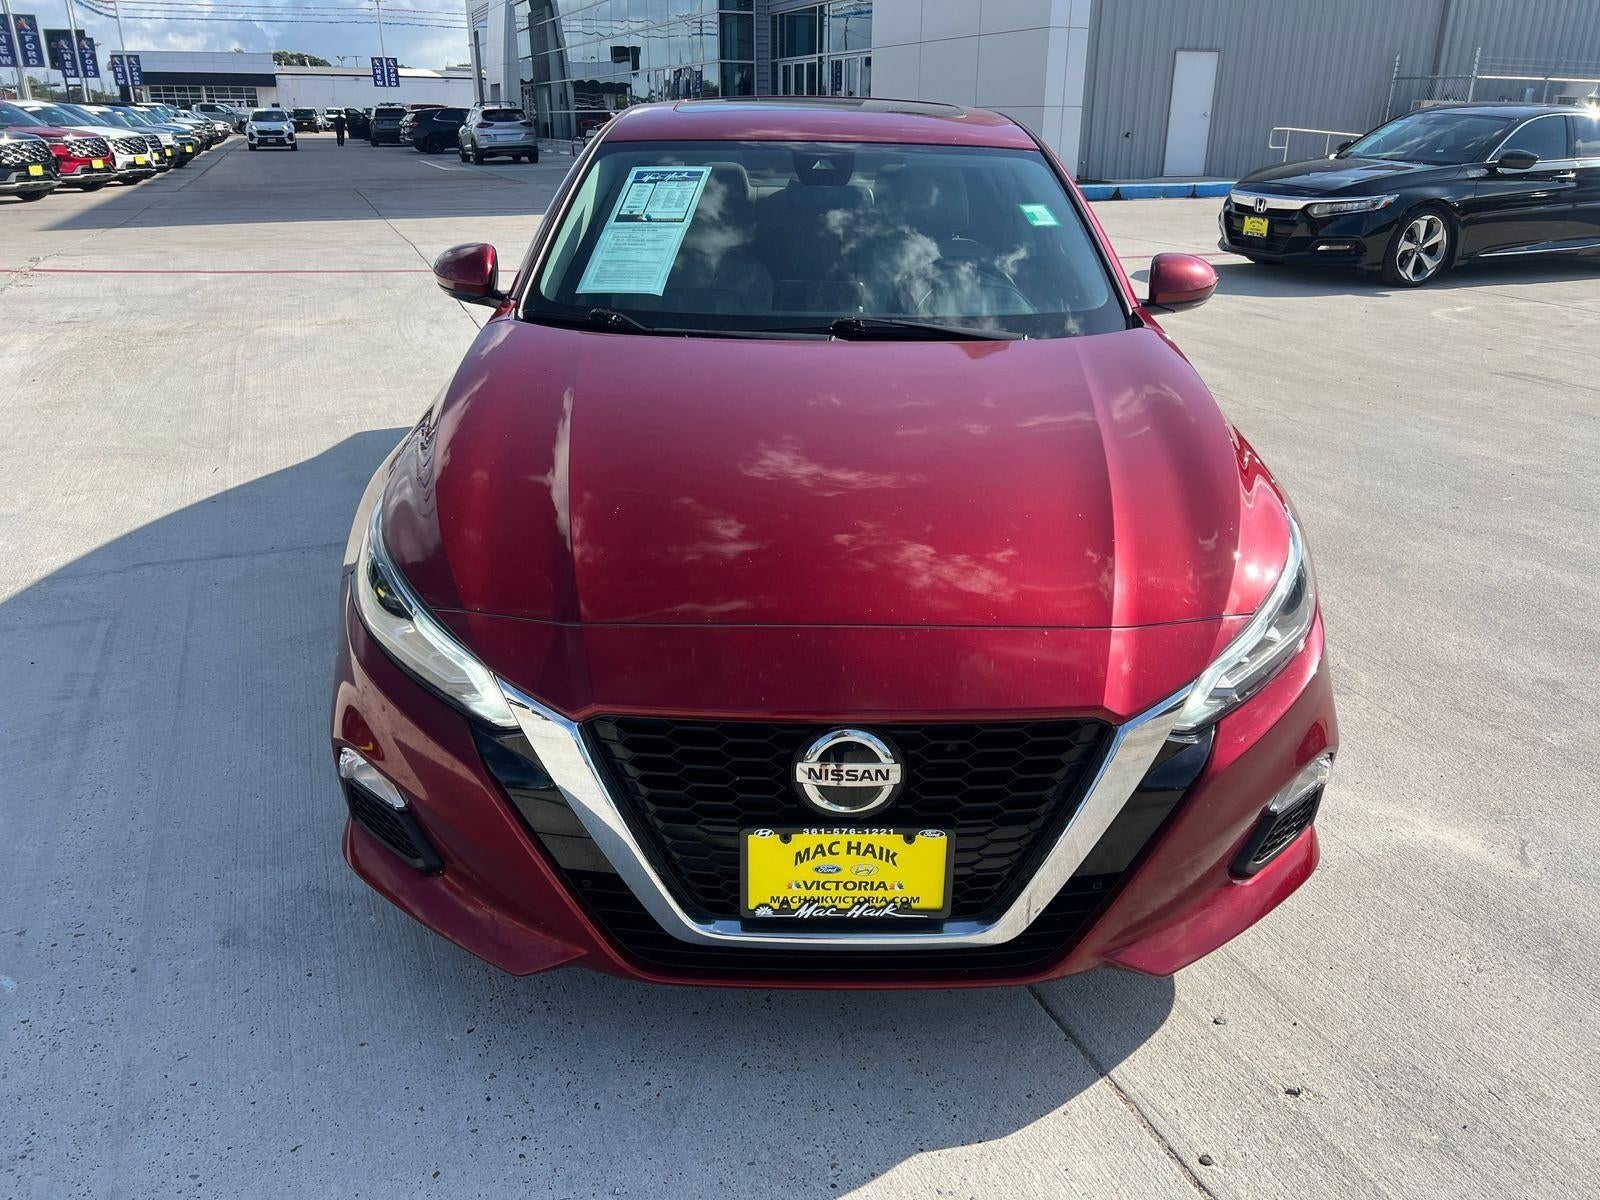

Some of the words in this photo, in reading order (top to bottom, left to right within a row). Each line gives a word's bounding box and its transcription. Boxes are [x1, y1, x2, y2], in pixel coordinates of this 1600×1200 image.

[24, 35, 38, 65] FORD
[63, 53, 75, 77] NEW
[85, 53, 95, 77] FORD
[115, 67, 125, 85] NEW
[132, 67, 140, 86] FORD
[376, 69, 384, 86] NEW
[807, 767, 890, 782] NISSAN
[794, 841, 840, 867] MAC
[846, 841, 898, 867] HAIK
[802, 880, 889, 891] VICTORIA
[794, 902, 837, 919] Mac
[845, 902, 898, 918] Haik
